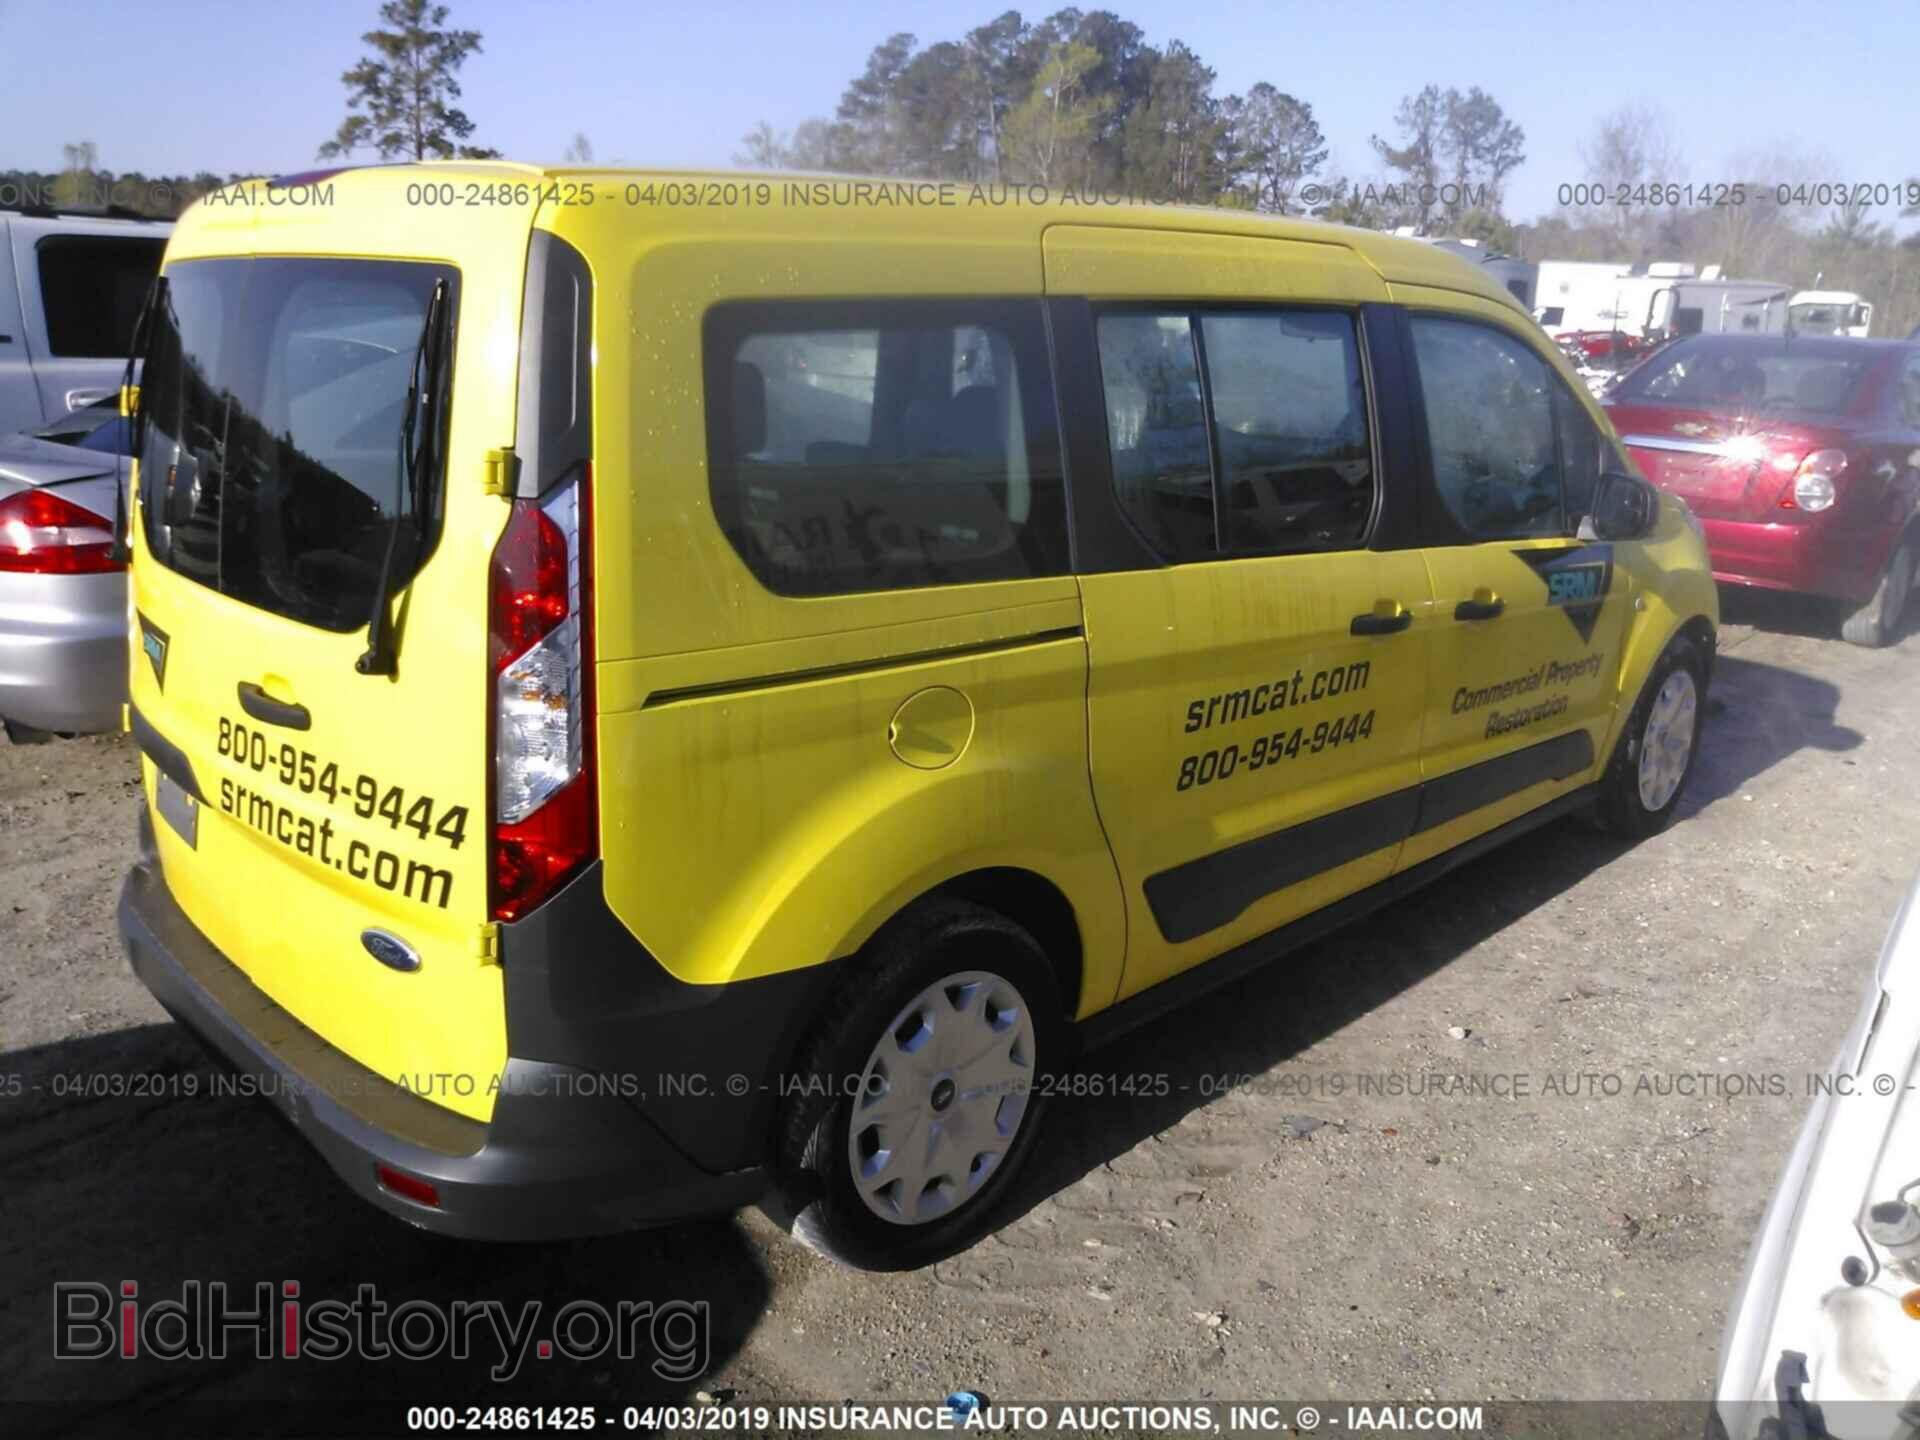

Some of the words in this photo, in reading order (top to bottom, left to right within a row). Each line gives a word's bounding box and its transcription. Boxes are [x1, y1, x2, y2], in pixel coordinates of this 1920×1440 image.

[1550, 571, 1597, 600] SRM
[1184, 660, 1371, 733] srmcat.com
[1451, 663, 1542, 715] Commercial
[1546, 650, 1605, 689] Property
[1484, 693, 1569, 740] Restoration
[217, 716, 470, 850] 800-954-9444
[1176, 709, 1376, 791] 800-954-9444
[220, 776, 454, 908] srmcat.com
